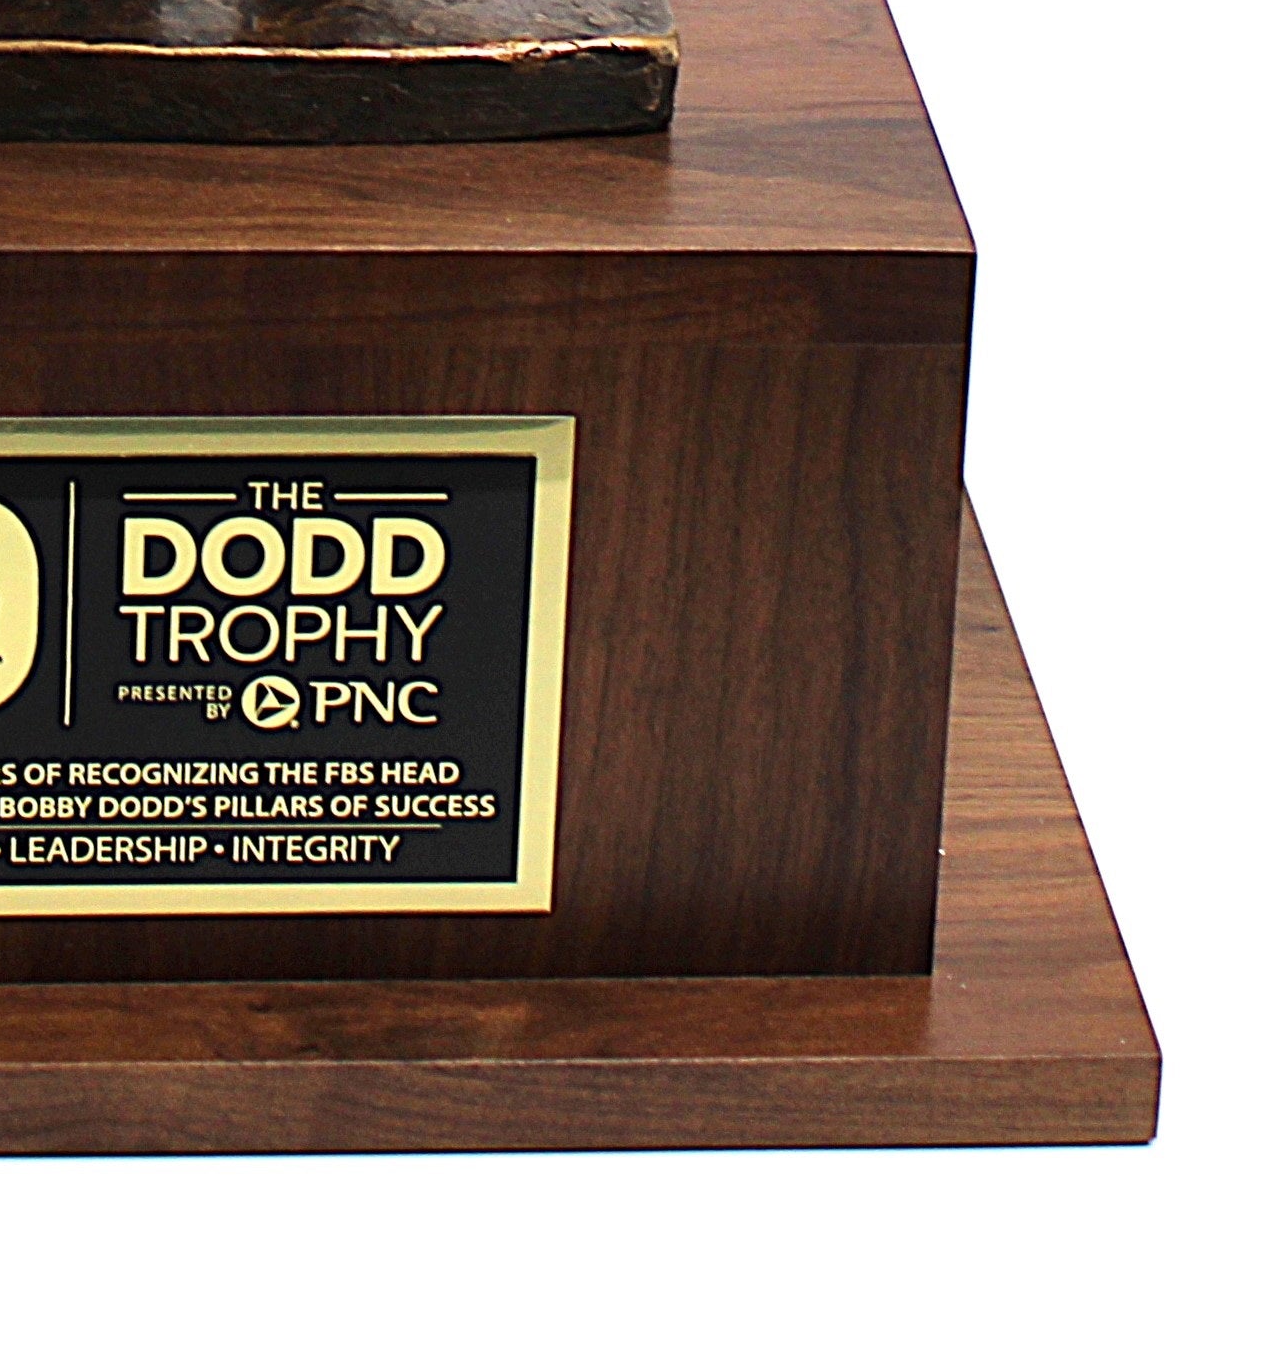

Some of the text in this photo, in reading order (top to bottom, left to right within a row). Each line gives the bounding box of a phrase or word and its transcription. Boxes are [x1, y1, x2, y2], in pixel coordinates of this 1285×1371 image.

[247, 481, 324, 511] THE
[122, 516, 446, 597] DODD
[118, 604, 443, 662] TROPHY
[118, 684, 233, 702] PRESENTED
[308, 680, 439, 723] PNC
[206, 702, 231, 720] BY
[23, 762, 62, 786] OF
[68, 762, 259, 786] RECOGNIZING
[263, 761, 318, 785] THE
[324, 761, 375, 785] FBS
[381, 761, 460, 784] HEAD
[0, 795, 93, 819] BOBBY
[98, 795, 208, 818] DODD'S
[214, 795, 324, 818] PILLARS
[329, 794, 369, 818] OF
[374, 794, 496, 818] SUCCESS
[10, 835, 208, 863] LEADERSHIP
[232, 834, 401, 862] INTEGRITY
